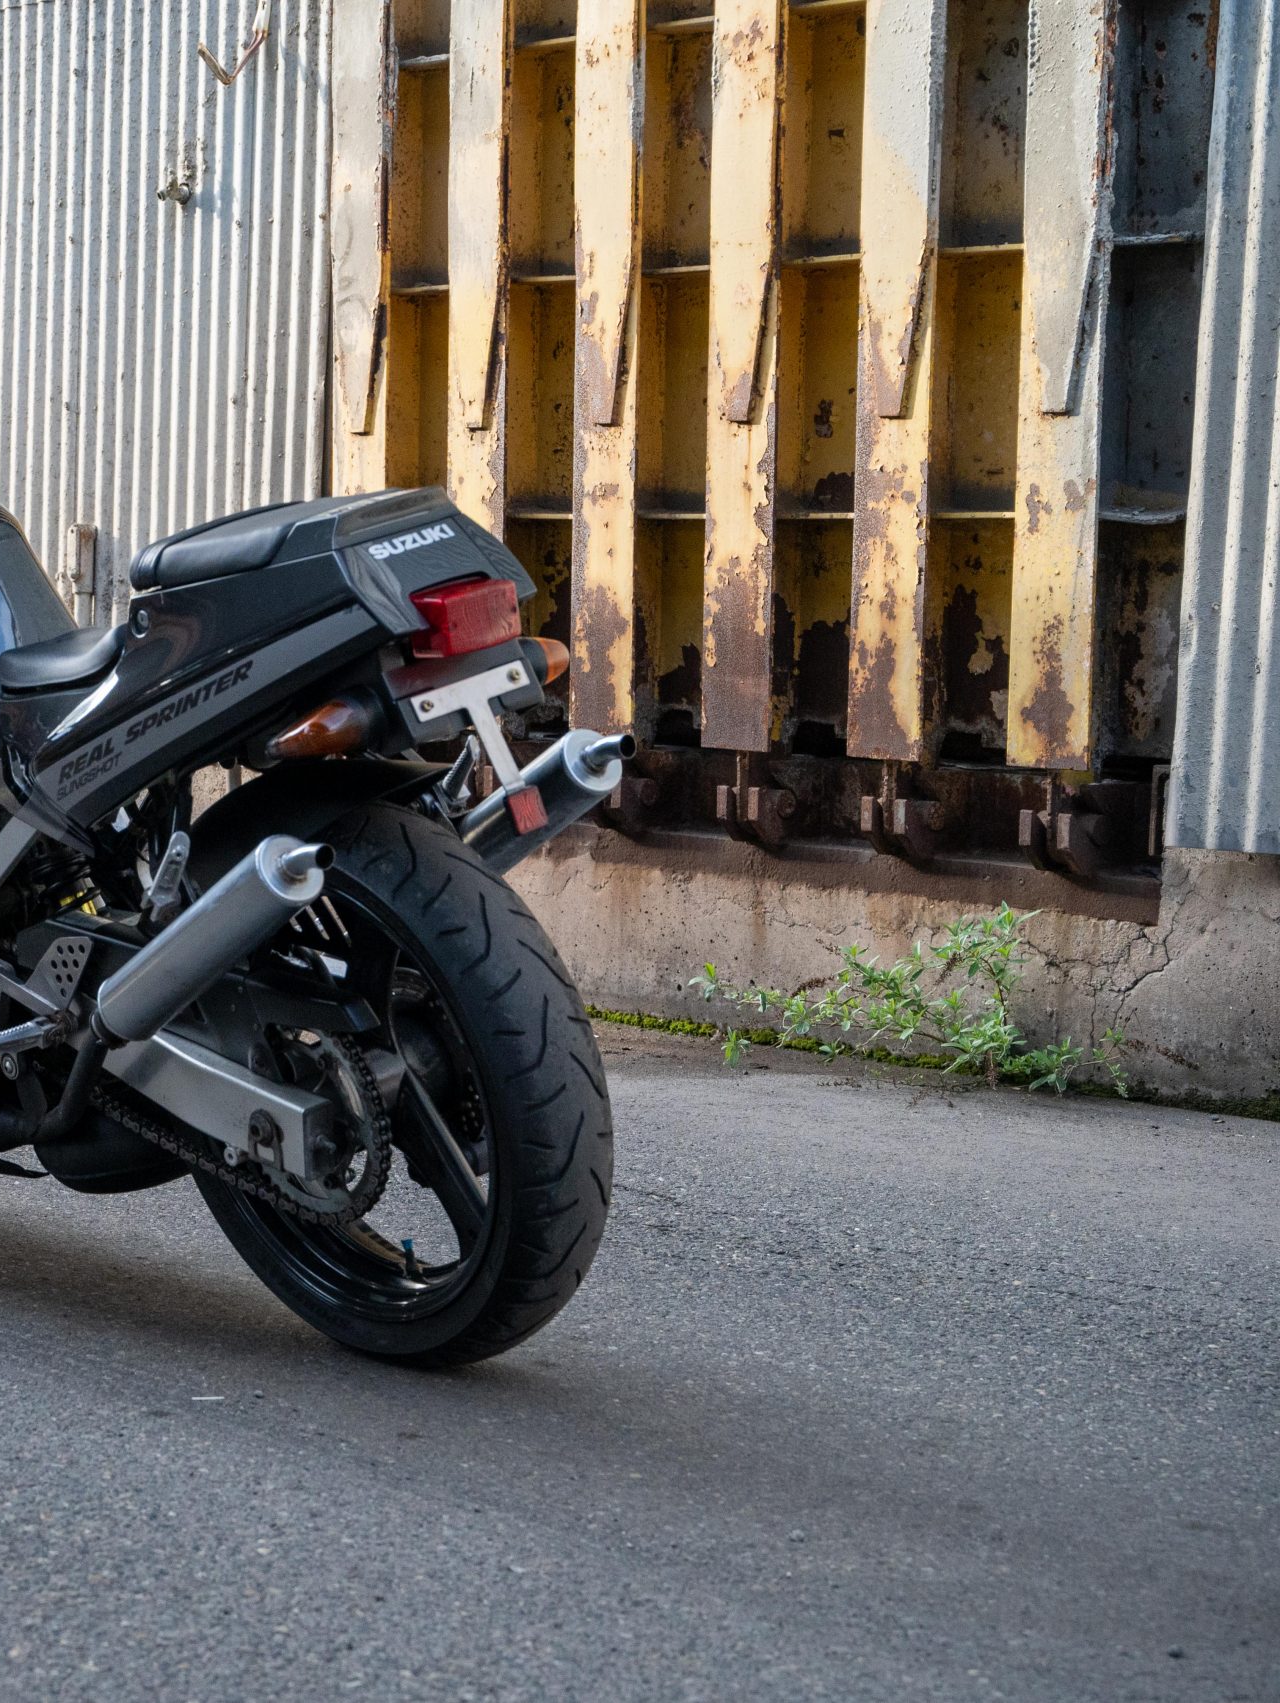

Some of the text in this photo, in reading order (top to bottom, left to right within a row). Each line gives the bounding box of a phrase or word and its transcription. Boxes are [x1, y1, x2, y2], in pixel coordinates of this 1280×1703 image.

[368, 523, 455, 560] SUZUKI
[58, 660, 253, 784] REAL SPRINTER
[56, 751, 123, 801] SLINGSHOT
